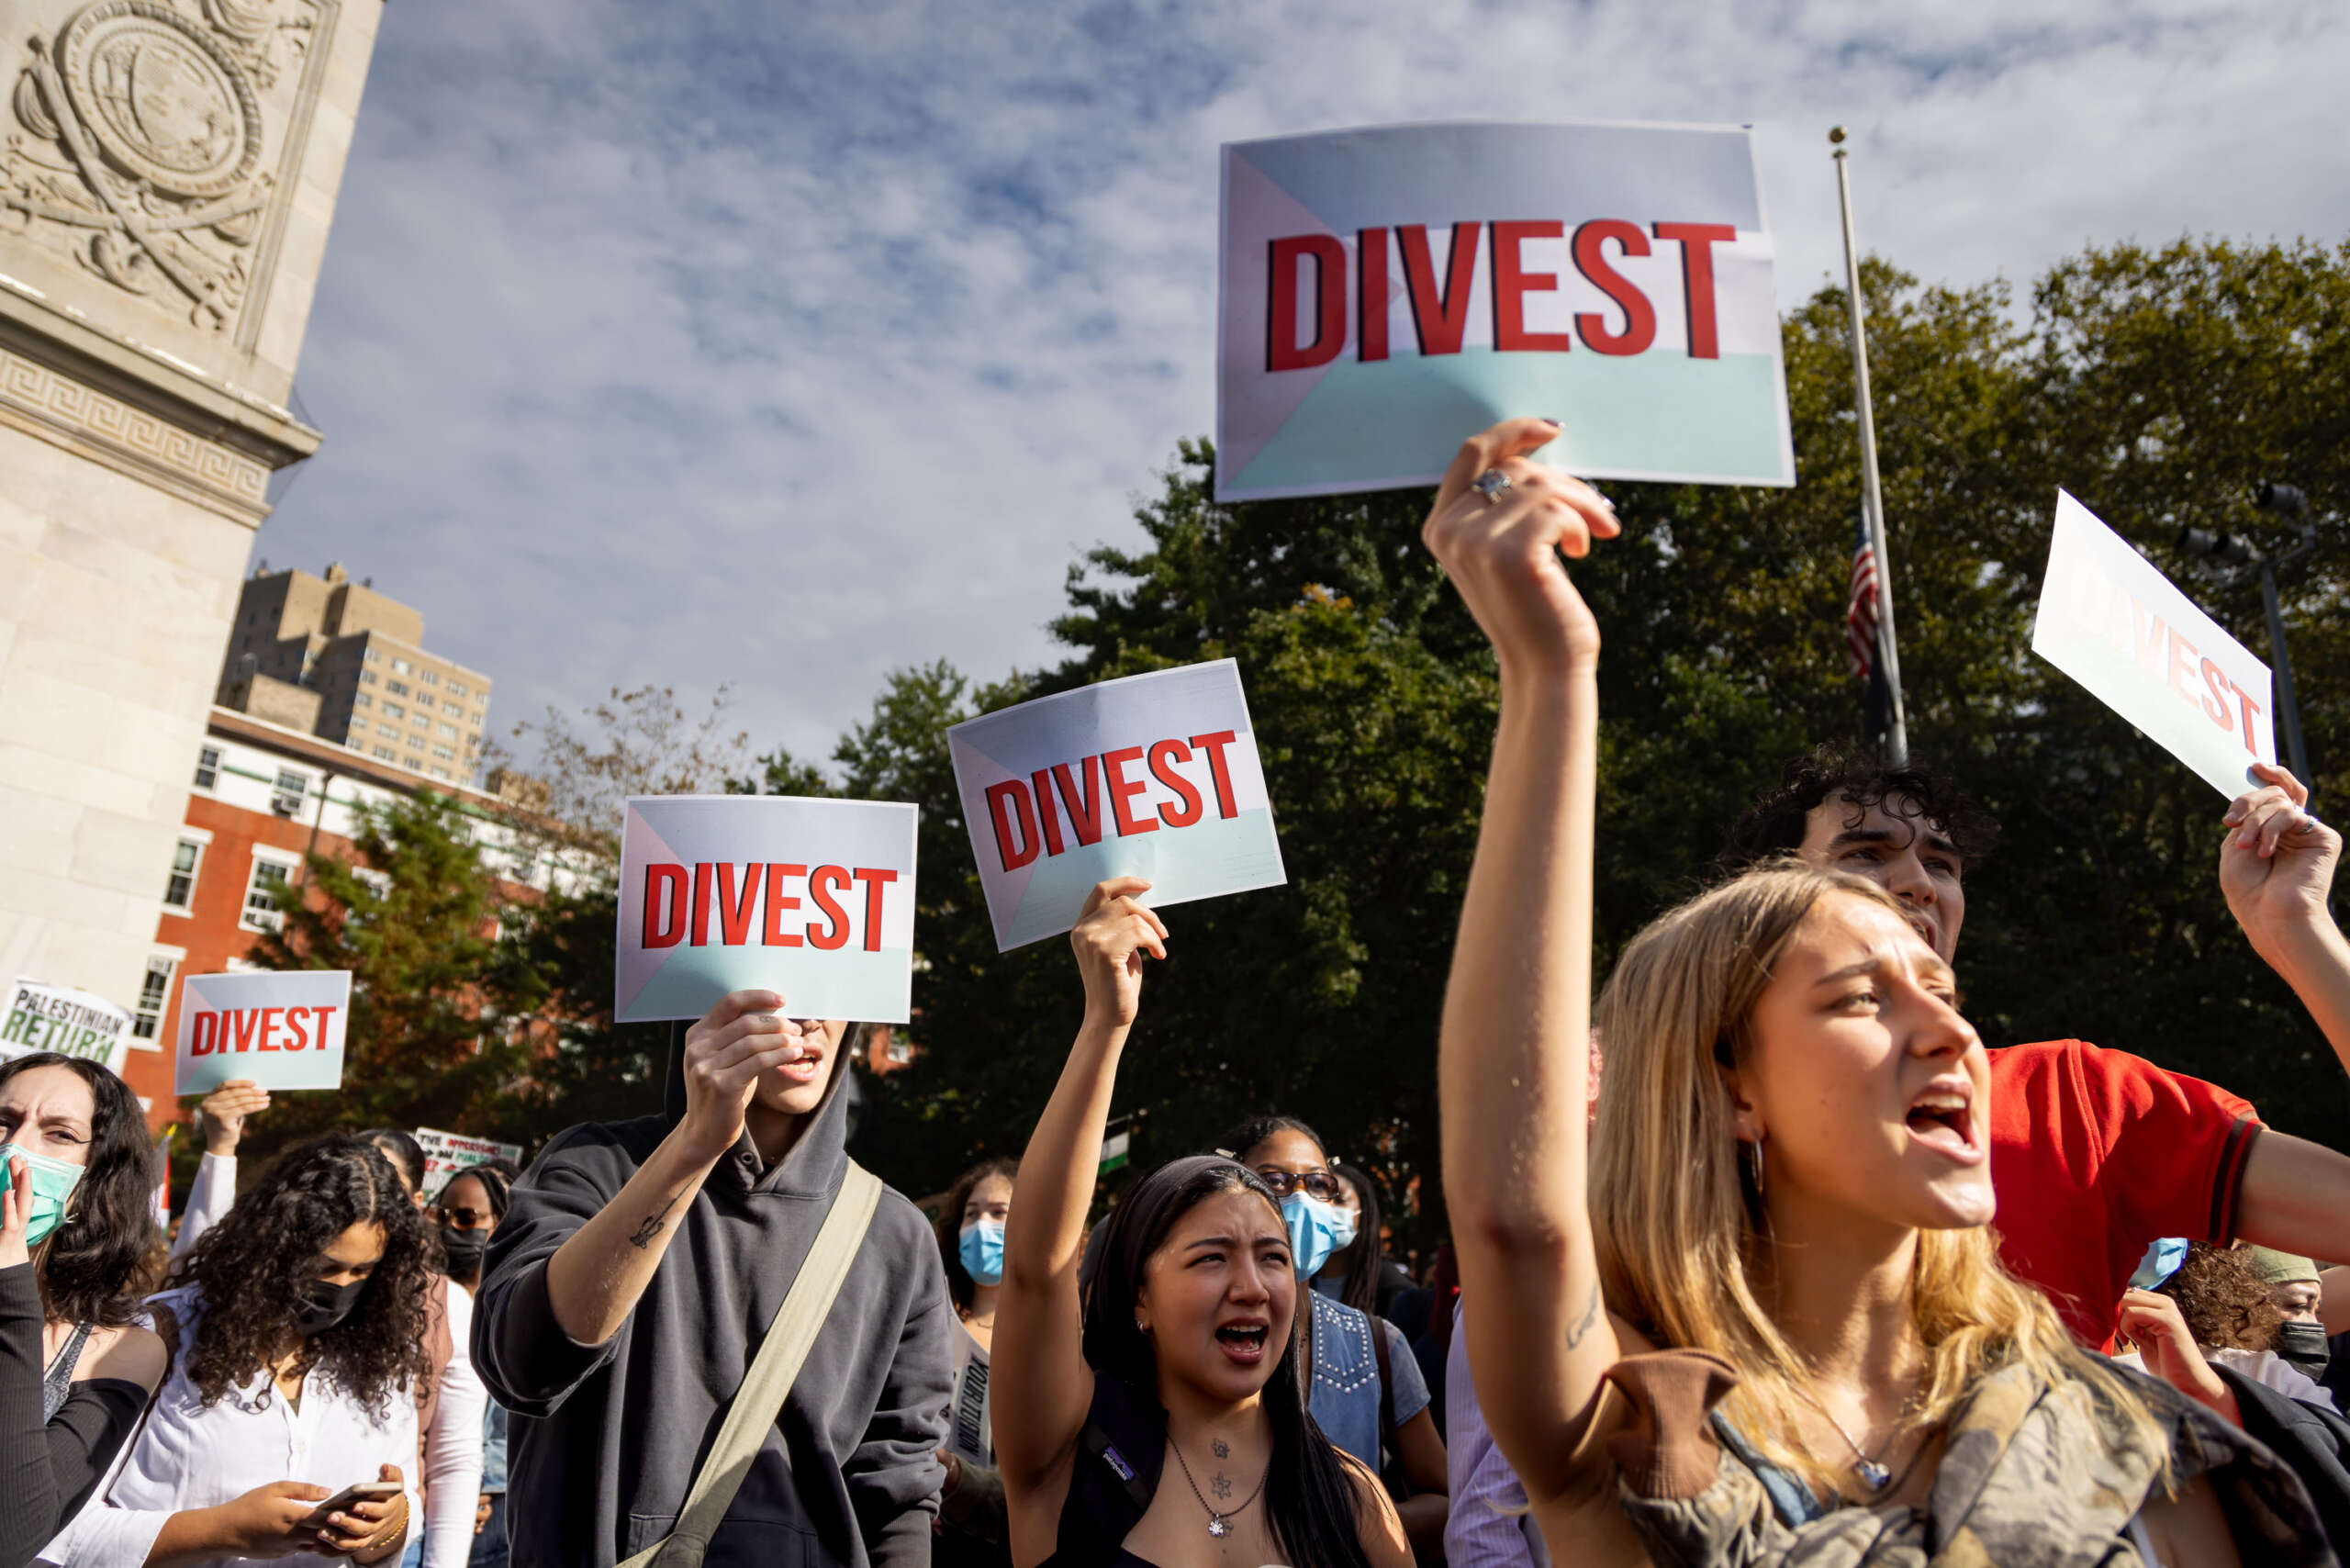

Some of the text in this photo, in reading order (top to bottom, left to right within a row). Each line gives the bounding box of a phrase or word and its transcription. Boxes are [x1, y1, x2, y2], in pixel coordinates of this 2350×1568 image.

[1266, 218, 1737, 372] DIVEST
[984, 729, 1238, 873] DIVEST
[642, 861, 898, 952] DIVEST
[1, 1009, 116, 1065] RETURN
[15, 988, 124, 1035] PALESTINIAN
[191, 1005, 337, 1057] DIVEST
[963, 1352, 990, 1405] YOUR
